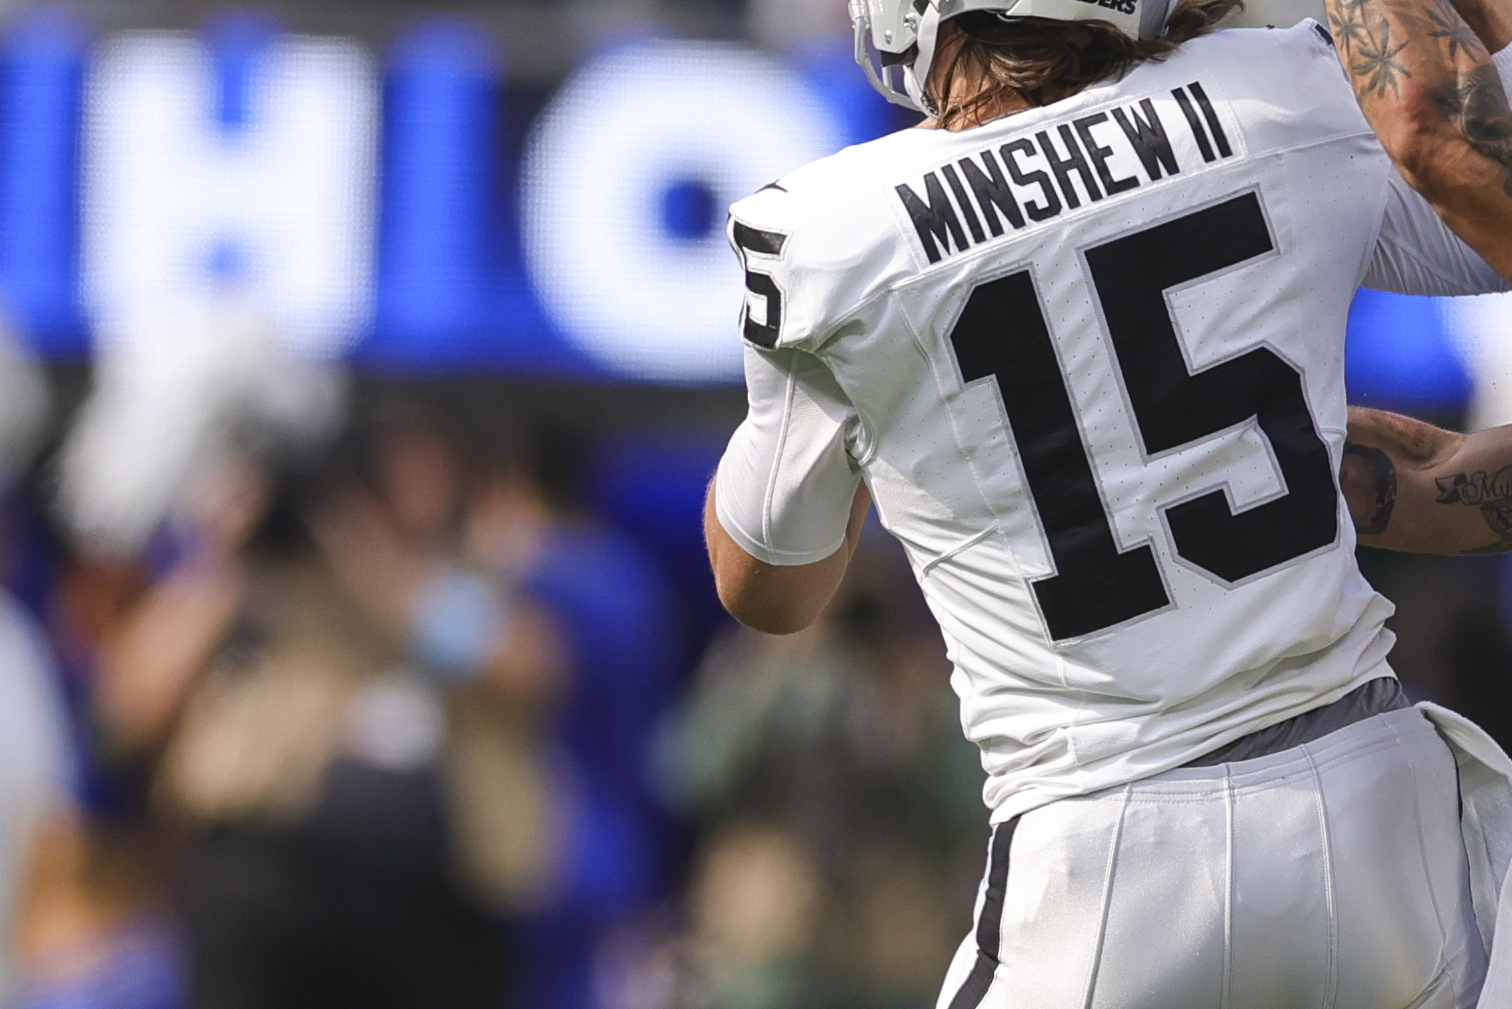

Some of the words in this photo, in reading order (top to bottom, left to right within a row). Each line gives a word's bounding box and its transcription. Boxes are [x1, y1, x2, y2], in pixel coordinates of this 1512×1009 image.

[895, 96, 1178, 265] MINSHEW
[1170, 81, 1232, 165] II
[946, 187, 1341, 645] 15
